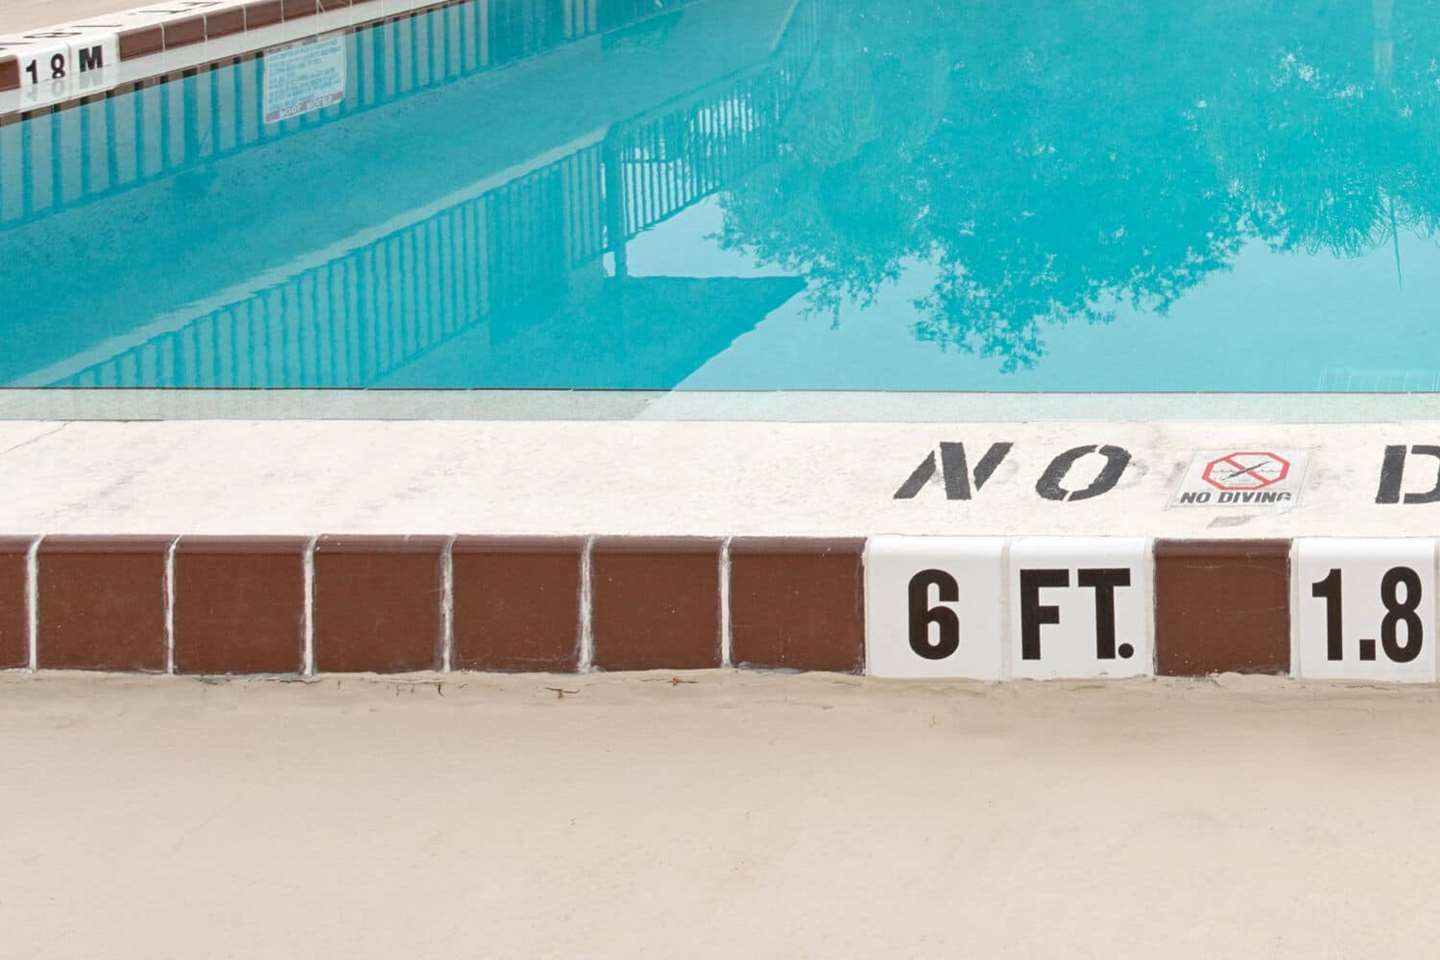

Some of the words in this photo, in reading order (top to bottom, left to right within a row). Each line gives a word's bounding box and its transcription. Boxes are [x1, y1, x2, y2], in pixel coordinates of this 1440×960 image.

[892, 441, 1133, 502] NO
[1179, 491, 1212, 504] NO
[1217, 491, 1293, 504] DIVING
[907, 568, 960, 660] 6
[1019, 568, 1135, 661] FT.
[1311, 565, 1424, 664] 1.8
